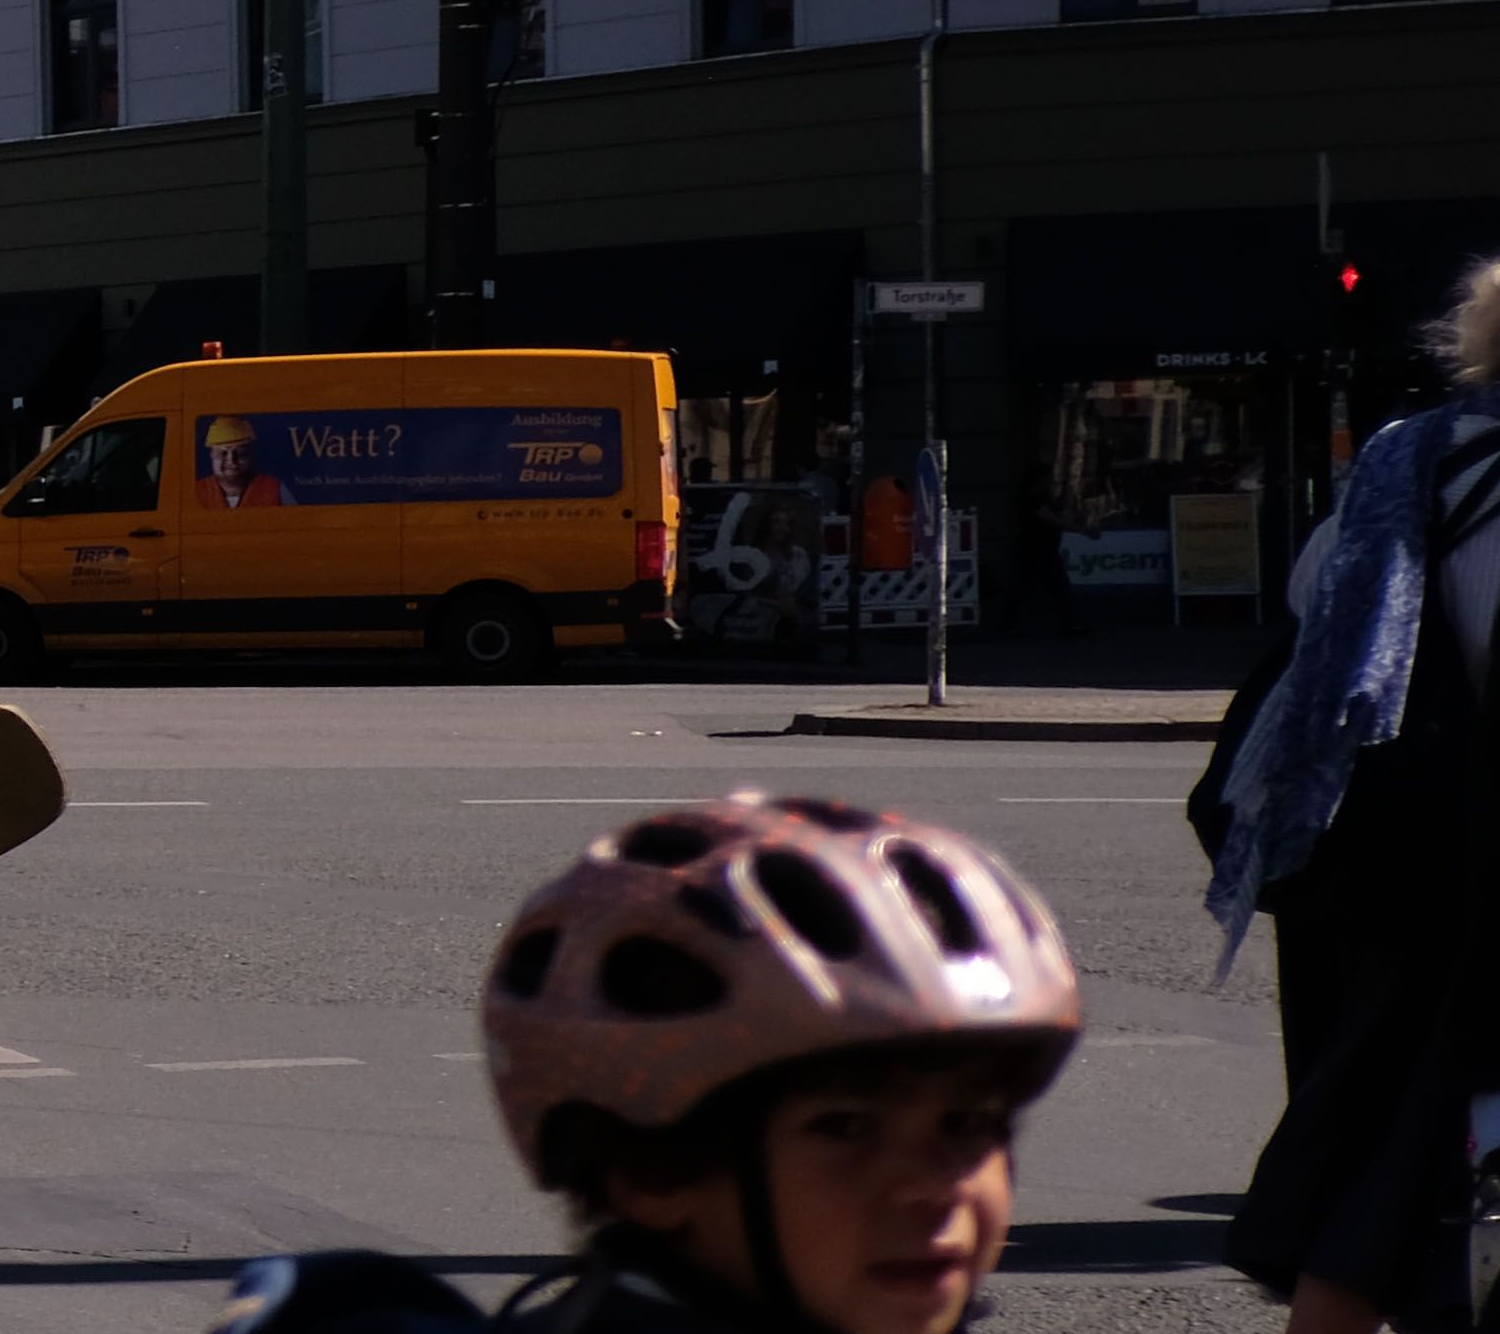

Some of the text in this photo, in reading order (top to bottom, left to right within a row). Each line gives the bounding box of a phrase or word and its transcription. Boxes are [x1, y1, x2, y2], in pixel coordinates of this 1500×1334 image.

[894, 289, 967, 306] Torstraße
[1156, 351, 1232, 367] DRINKS
[510, 412, 604, 429] Ausbildung
[287, 424, 402, 459] Watt?
[506, 441, 585, 465] TRP
[519, 468, 562, 483] Bau
